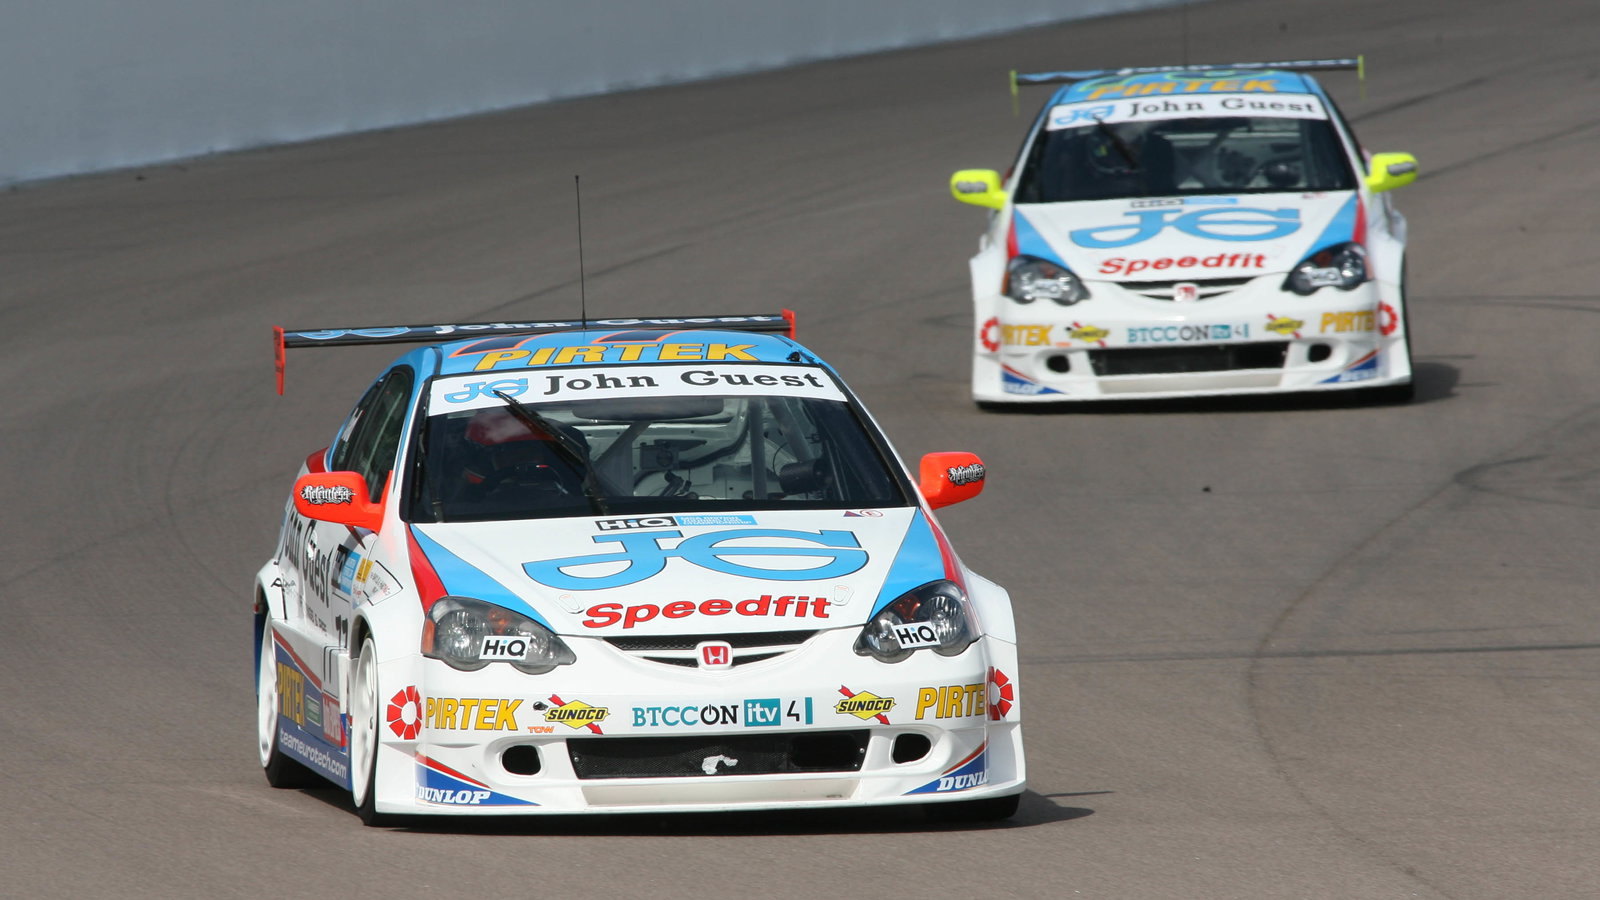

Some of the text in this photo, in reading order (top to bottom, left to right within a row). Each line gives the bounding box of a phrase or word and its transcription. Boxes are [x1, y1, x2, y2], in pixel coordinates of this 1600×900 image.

[1128, 100, 1205, 117] John
[1221, 98, 1316, 113] Guest
[1069, 207, 1302, 248] JG
[1098, 253, 1266, 277] Speedfit
[473, 343, 760, 372] PIRTEK
[443, 370, 825, 404] JG John Guest
[600, 517, 675, 530] HiQ
[521, 528, 870, 592] JG
[582, 595, 832, 629] Speedfit
[896, 625, 938, 645] HiQ
[482, 638, 527, 657] HiQ
[425, 697, 524, 731] PIRTEK
[547, 708, 606, 721] SUNOCO
[747, 702, 778, 723] itv
[837, 699, 893, 713] SUNOCO
[280, 727, 347, 780] teameurotech.com
[417, 785, 491, 805] DUNLOP
